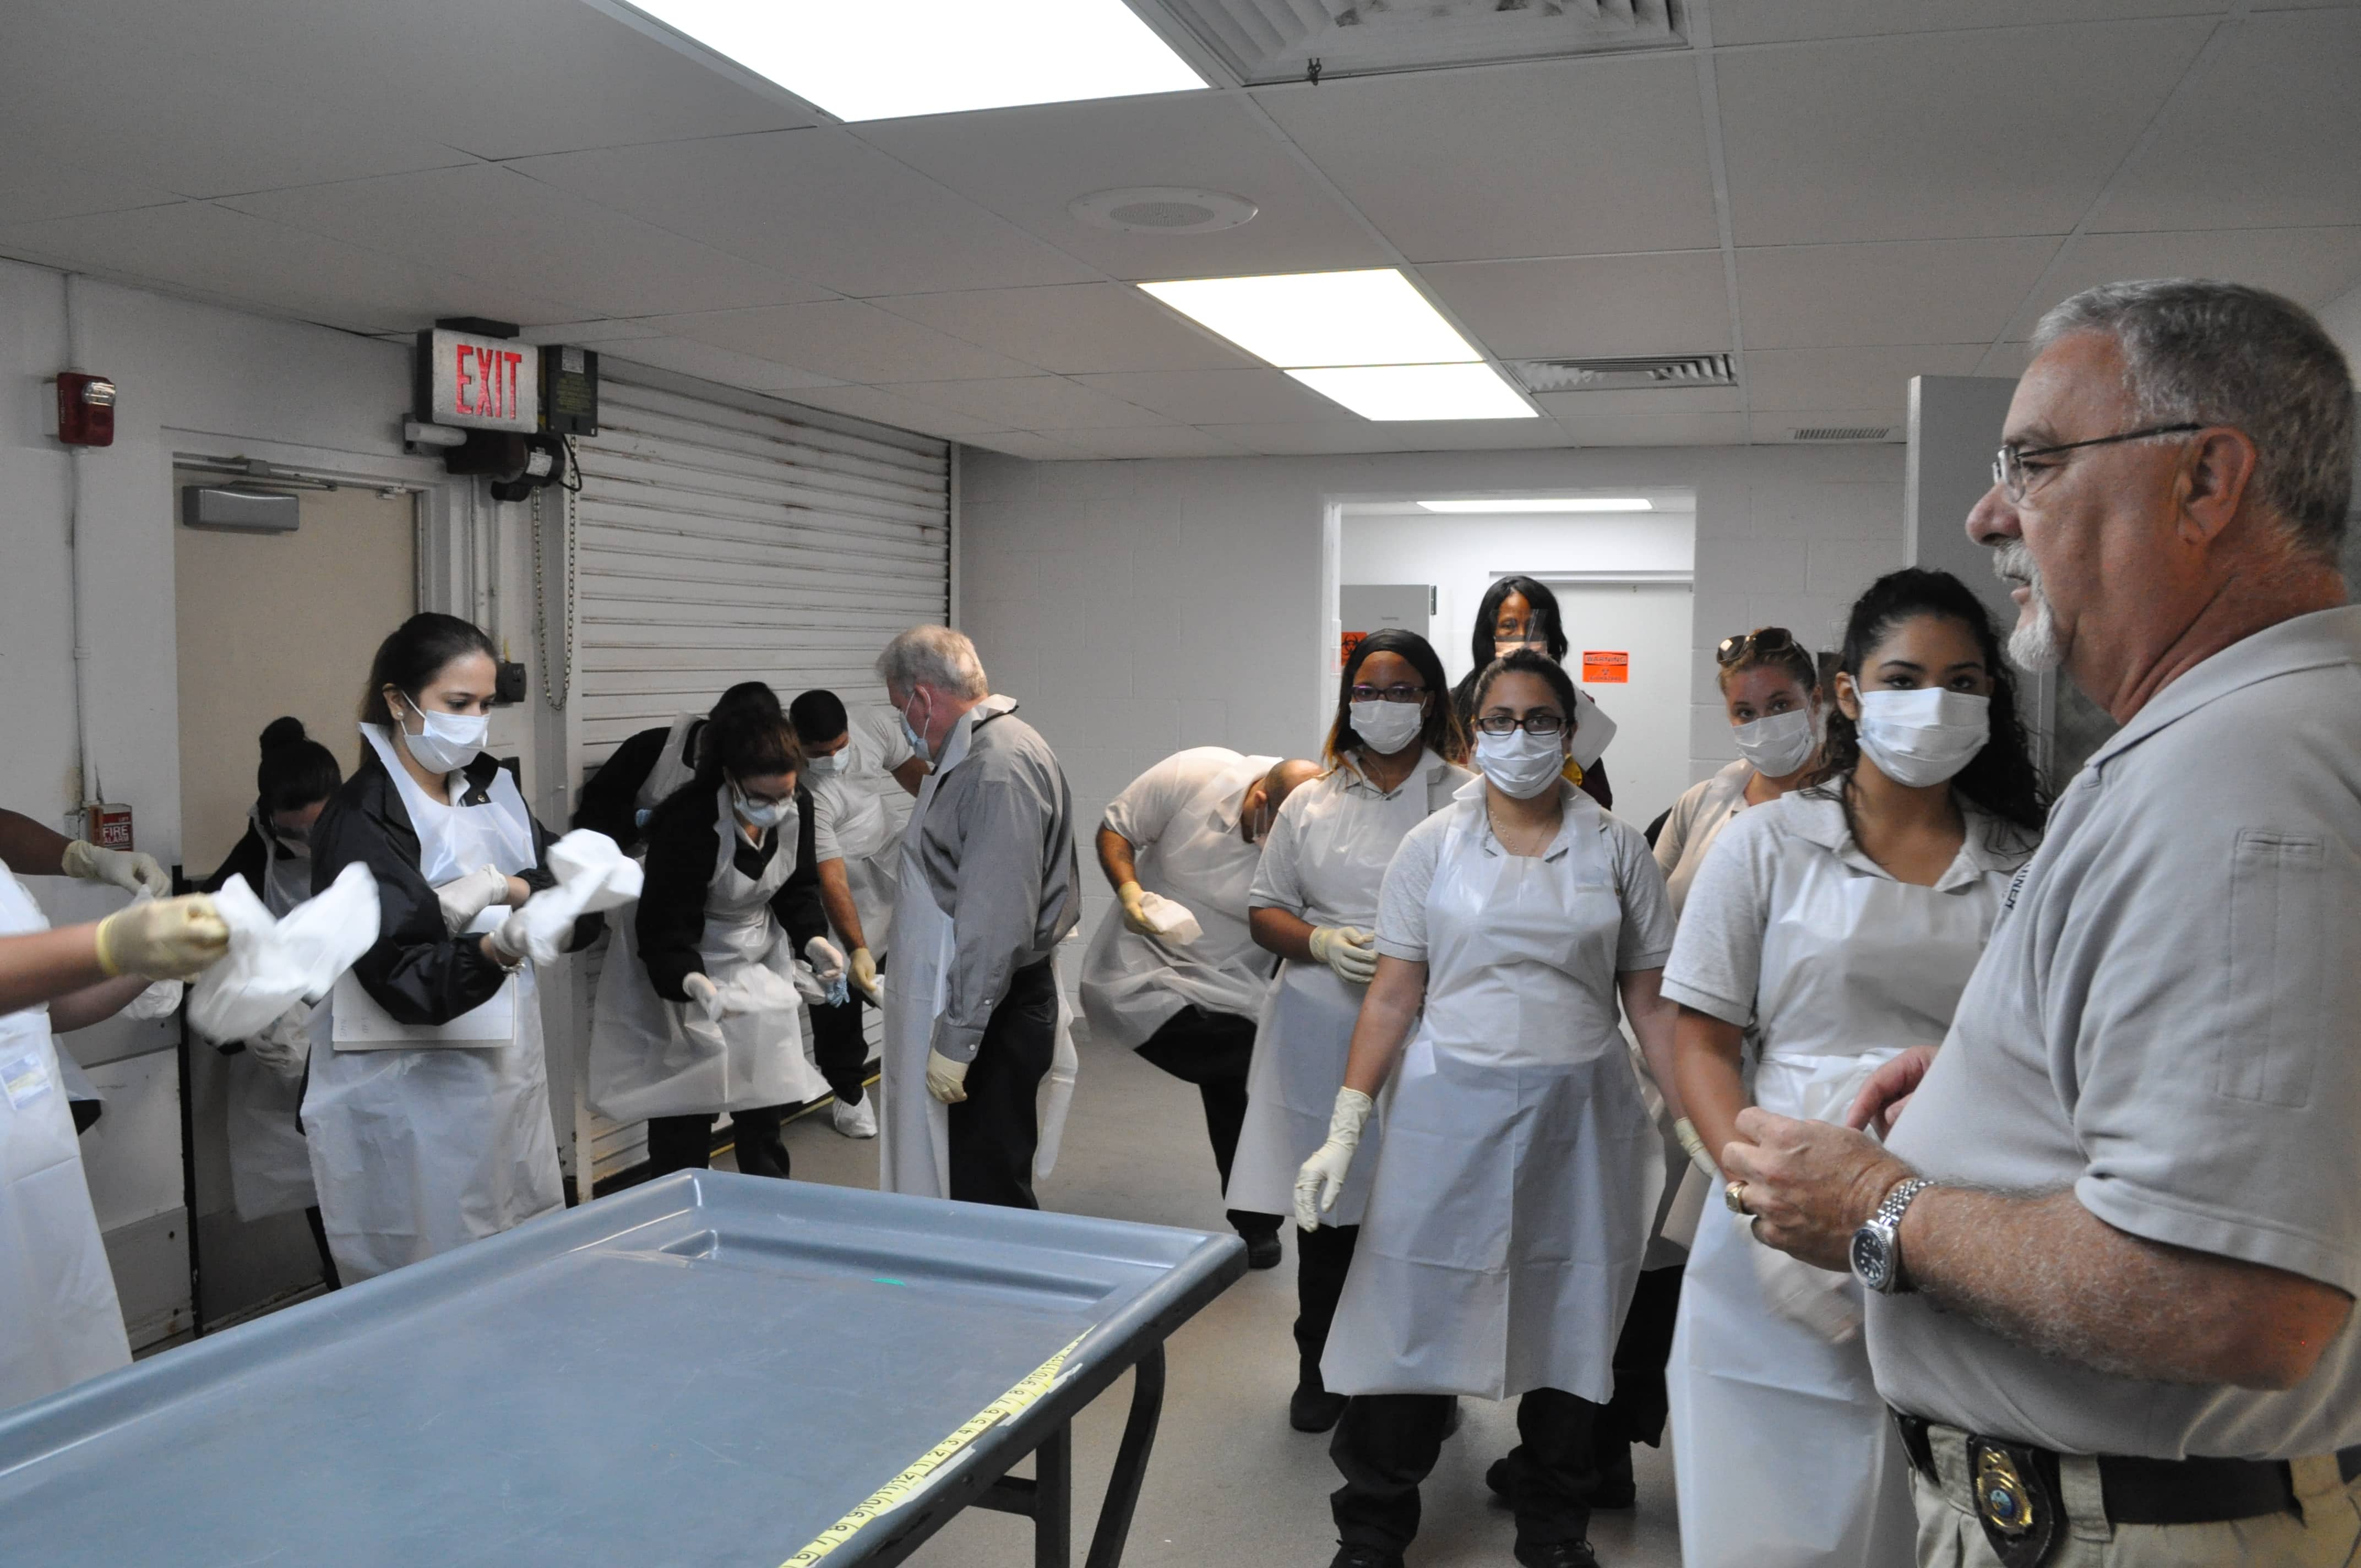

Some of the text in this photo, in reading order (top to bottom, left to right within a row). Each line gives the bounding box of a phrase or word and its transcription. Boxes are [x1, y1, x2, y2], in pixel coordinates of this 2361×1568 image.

[456, 344, 522, 420] EXIT
[103, 826, 128, 837] FIRE
[857, 1499, 882, 1509] 10
[876, 1486, 899, 1495] 11
[891, 1474, 915, 1483] 12
[1028, 1371, 1048, 1380] 10
